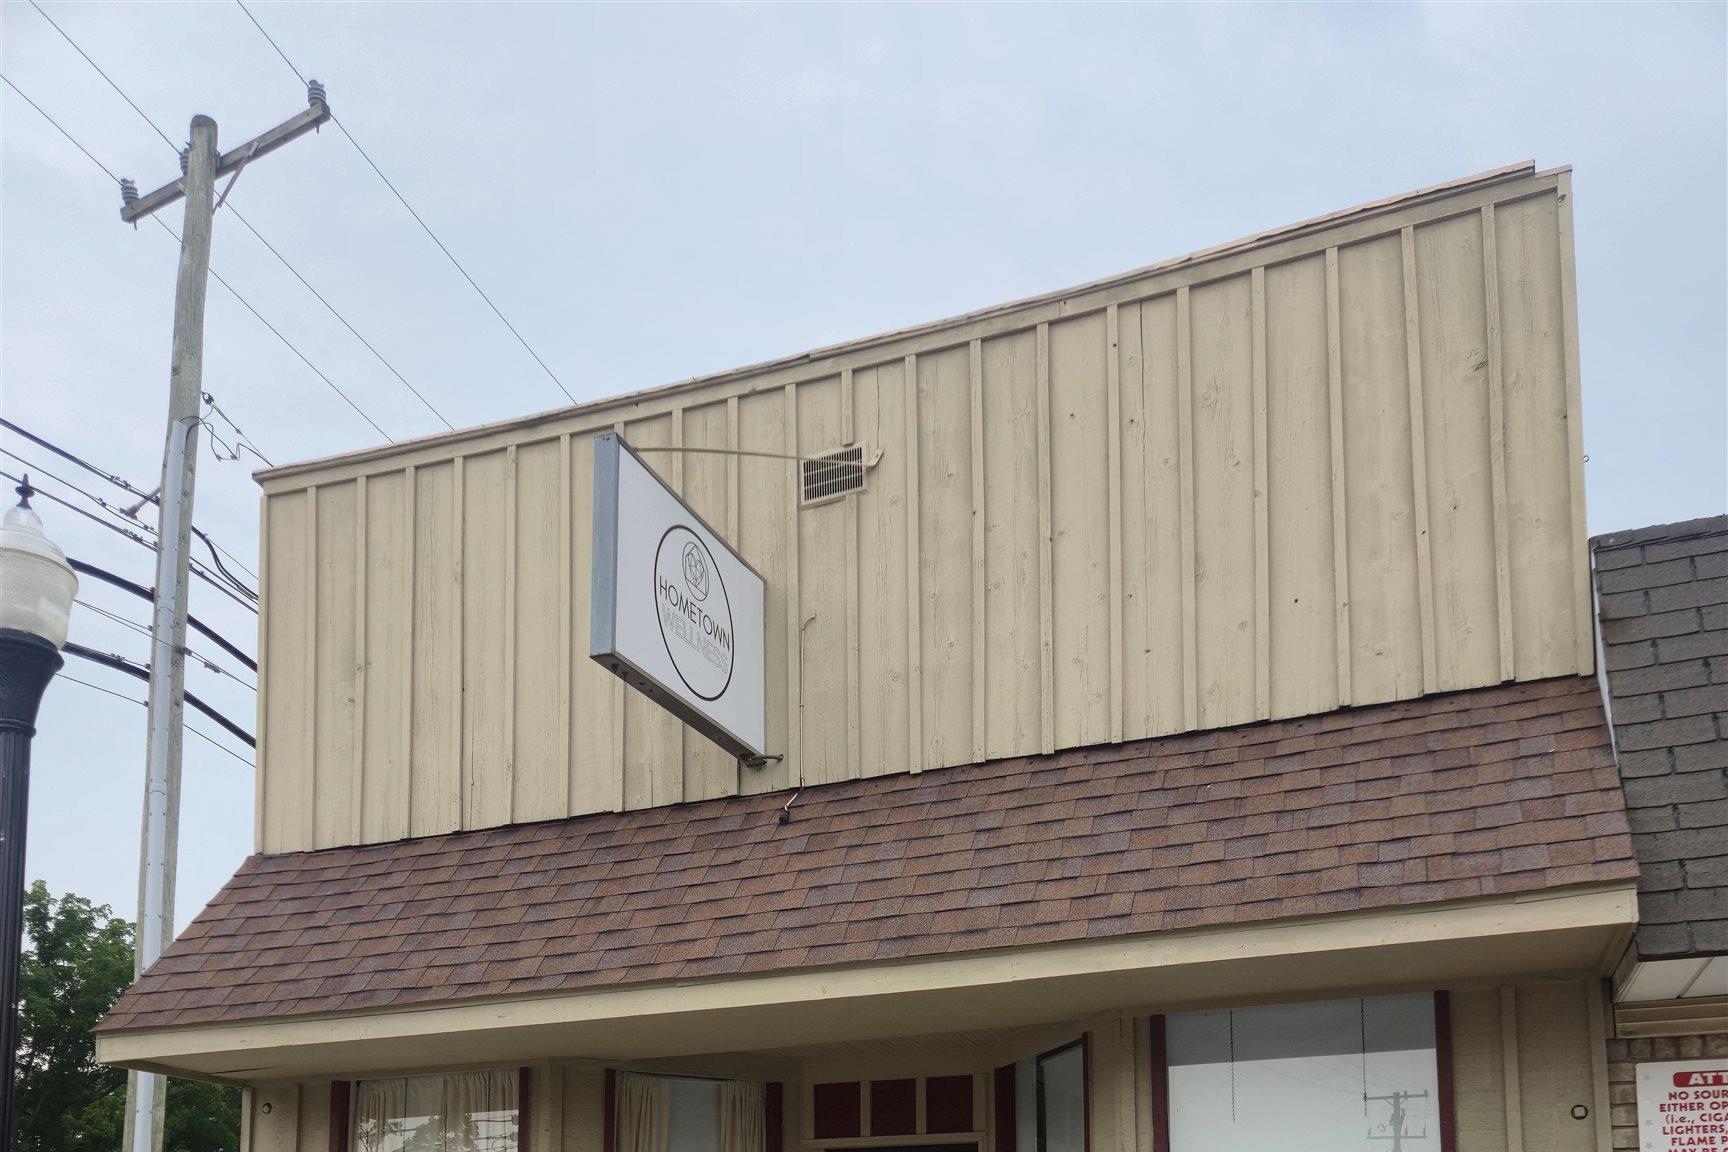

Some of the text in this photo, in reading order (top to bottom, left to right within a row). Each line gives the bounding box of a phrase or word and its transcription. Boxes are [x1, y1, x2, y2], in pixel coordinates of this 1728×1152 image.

[659, 575, 730, 652] HOMETOWN
[661, 603, 728, 674] WELLNESS
[1668, 1091, 1689, 1100] NO
[1660, 1102, 1705, 1112] EITHER
[1662, 1124, 1728, 1135] LIGHTERS,
[1671, 1136, 1716, 1146] FLAME
